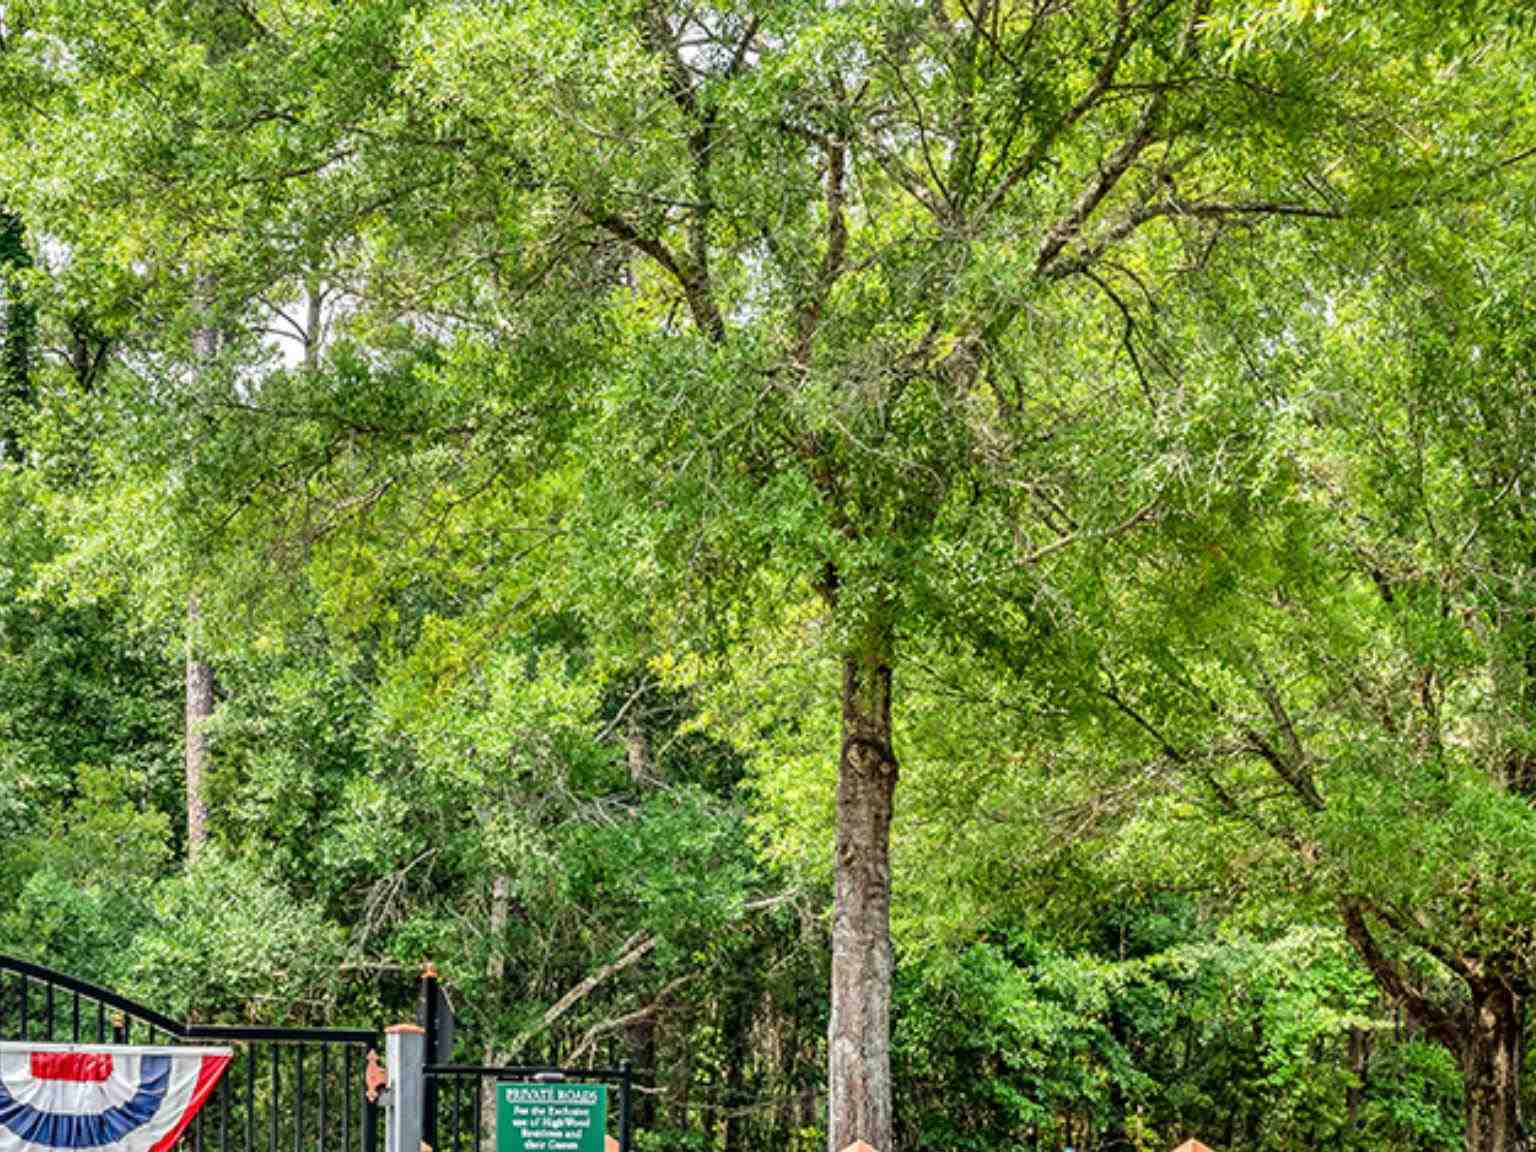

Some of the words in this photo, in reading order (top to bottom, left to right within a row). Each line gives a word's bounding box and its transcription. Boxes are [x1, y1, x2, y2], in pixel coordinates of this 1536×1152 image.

[506, 1088, 553, 1103] PRIVATE
[557, 1089, 598, 1104] ROADS
[531, 1106, 545, 1116] the
[530, 1117, 541, 1127] of
[564, 1129, 582, 1138] and
